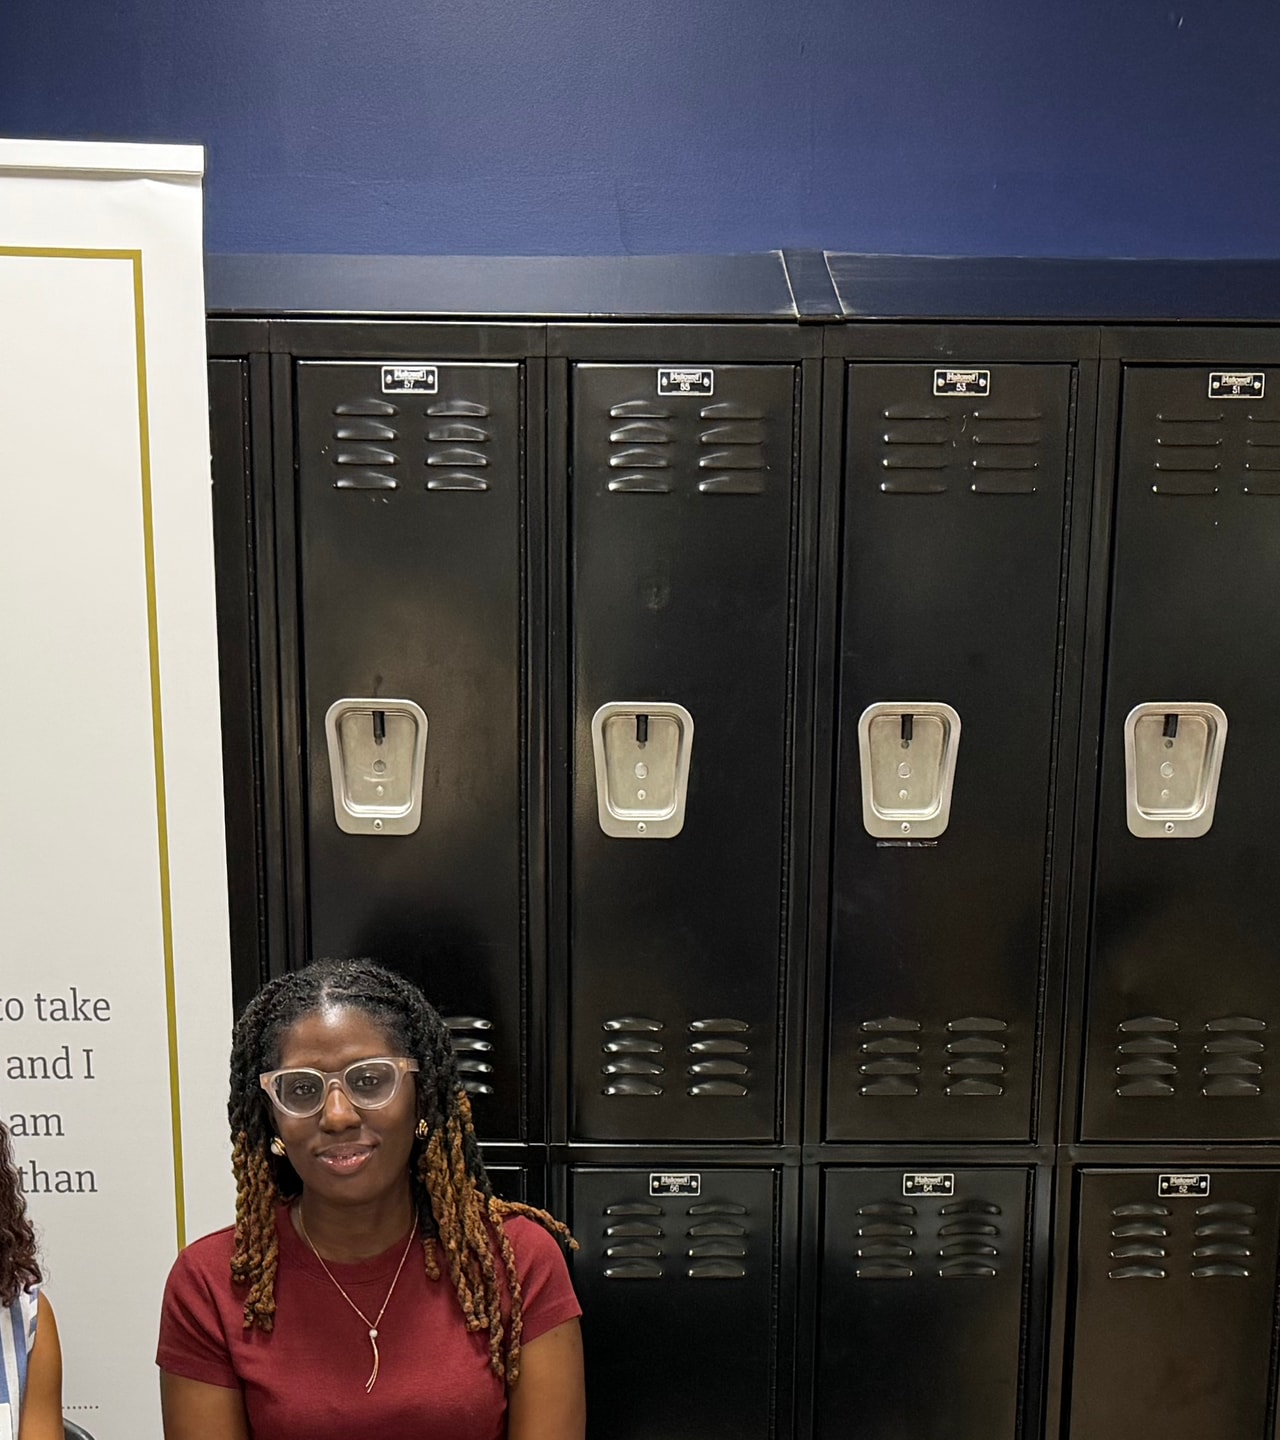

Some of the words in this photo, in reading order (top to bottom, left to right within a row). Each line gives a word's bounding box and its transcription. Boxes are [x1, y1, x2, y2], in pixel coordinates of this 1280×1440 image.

[34, 987, 111, 1022] take
[7, 1046, 73, 1080] and
[82, 1049, 95, 1079] I
[10, 1113, 65, 1137] am
[19, 1160, 98, 1193] than
